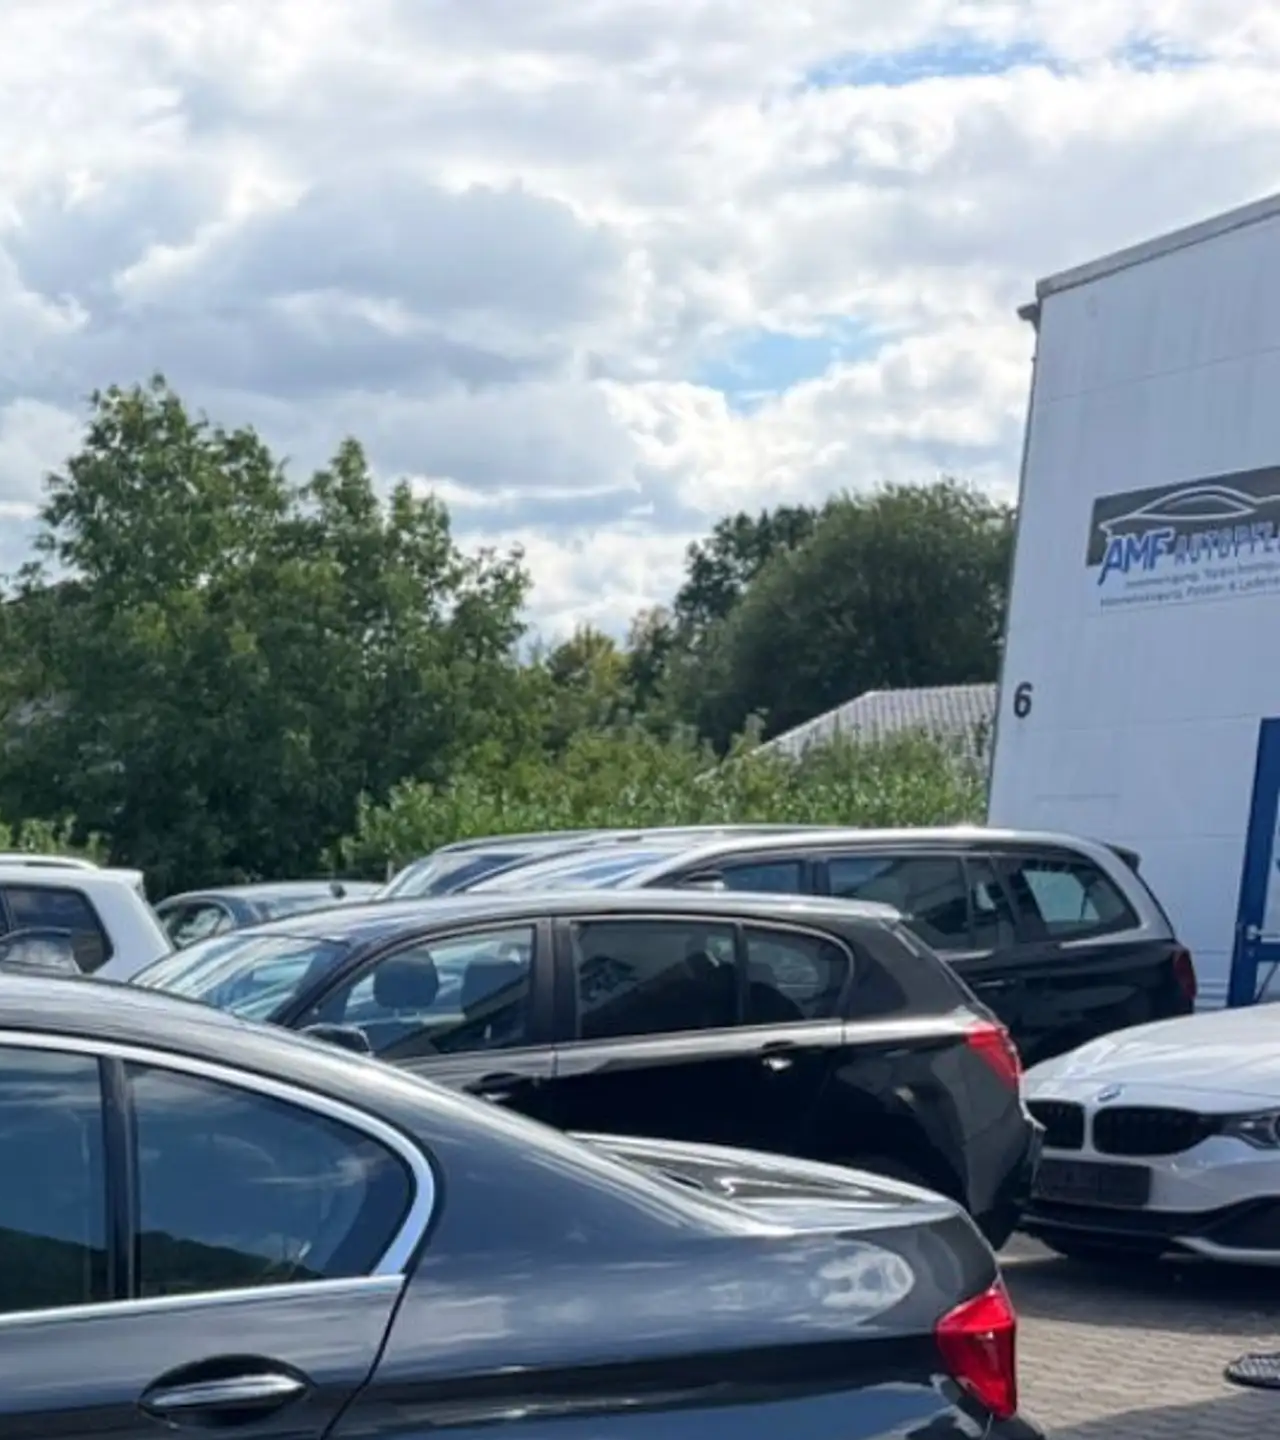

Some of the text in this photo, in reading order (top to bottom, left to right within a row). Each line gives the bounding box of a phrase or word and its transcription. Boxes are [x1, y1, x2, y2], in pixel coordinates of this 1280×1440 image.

[1097, 527, 1175, 586] AMF
[1174, 520, 1280, 565] AUTOPFL
[1014, 682, 1033, 719] 6
